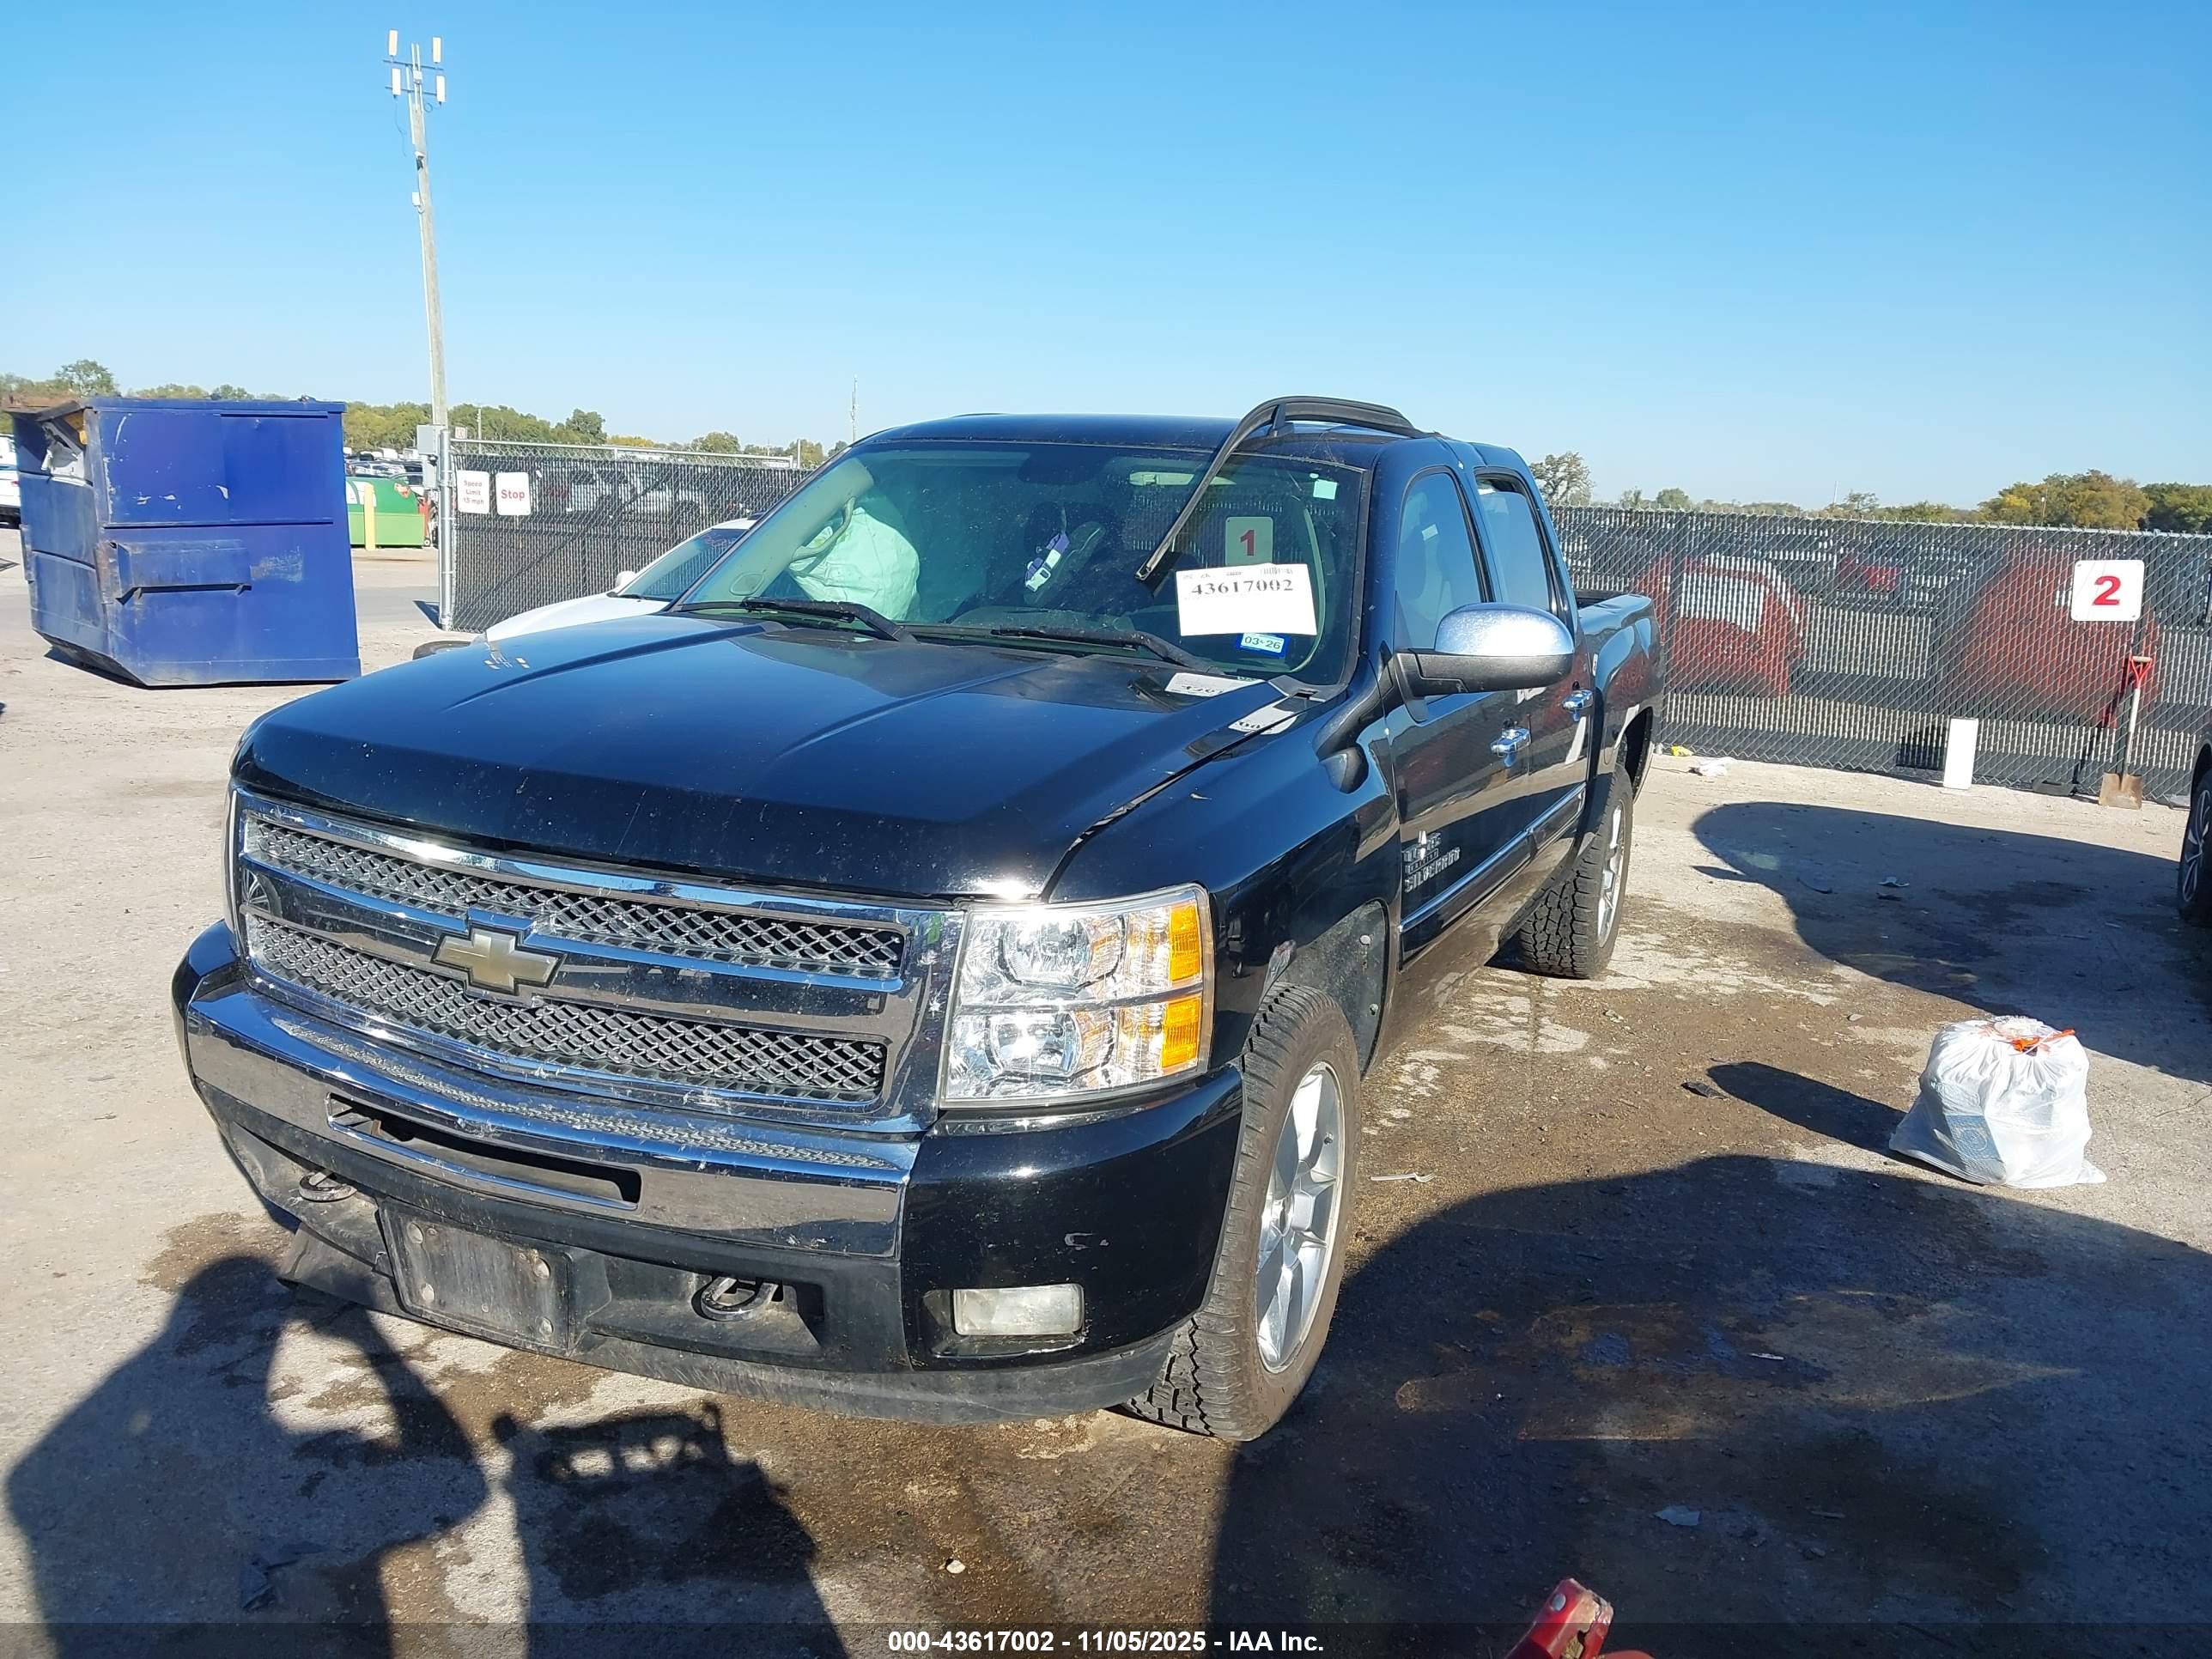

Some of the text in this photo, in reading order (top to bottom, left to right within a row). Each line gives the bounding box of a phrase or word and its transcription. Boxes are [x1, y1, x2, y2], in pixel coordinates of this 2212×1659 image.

[501, 489, 525, 501] Stop
[1240, 529, 1255, 556] 1
[1191, 579, 1294, 595] 43617002
[2092, 575, 2121, 605] 2
